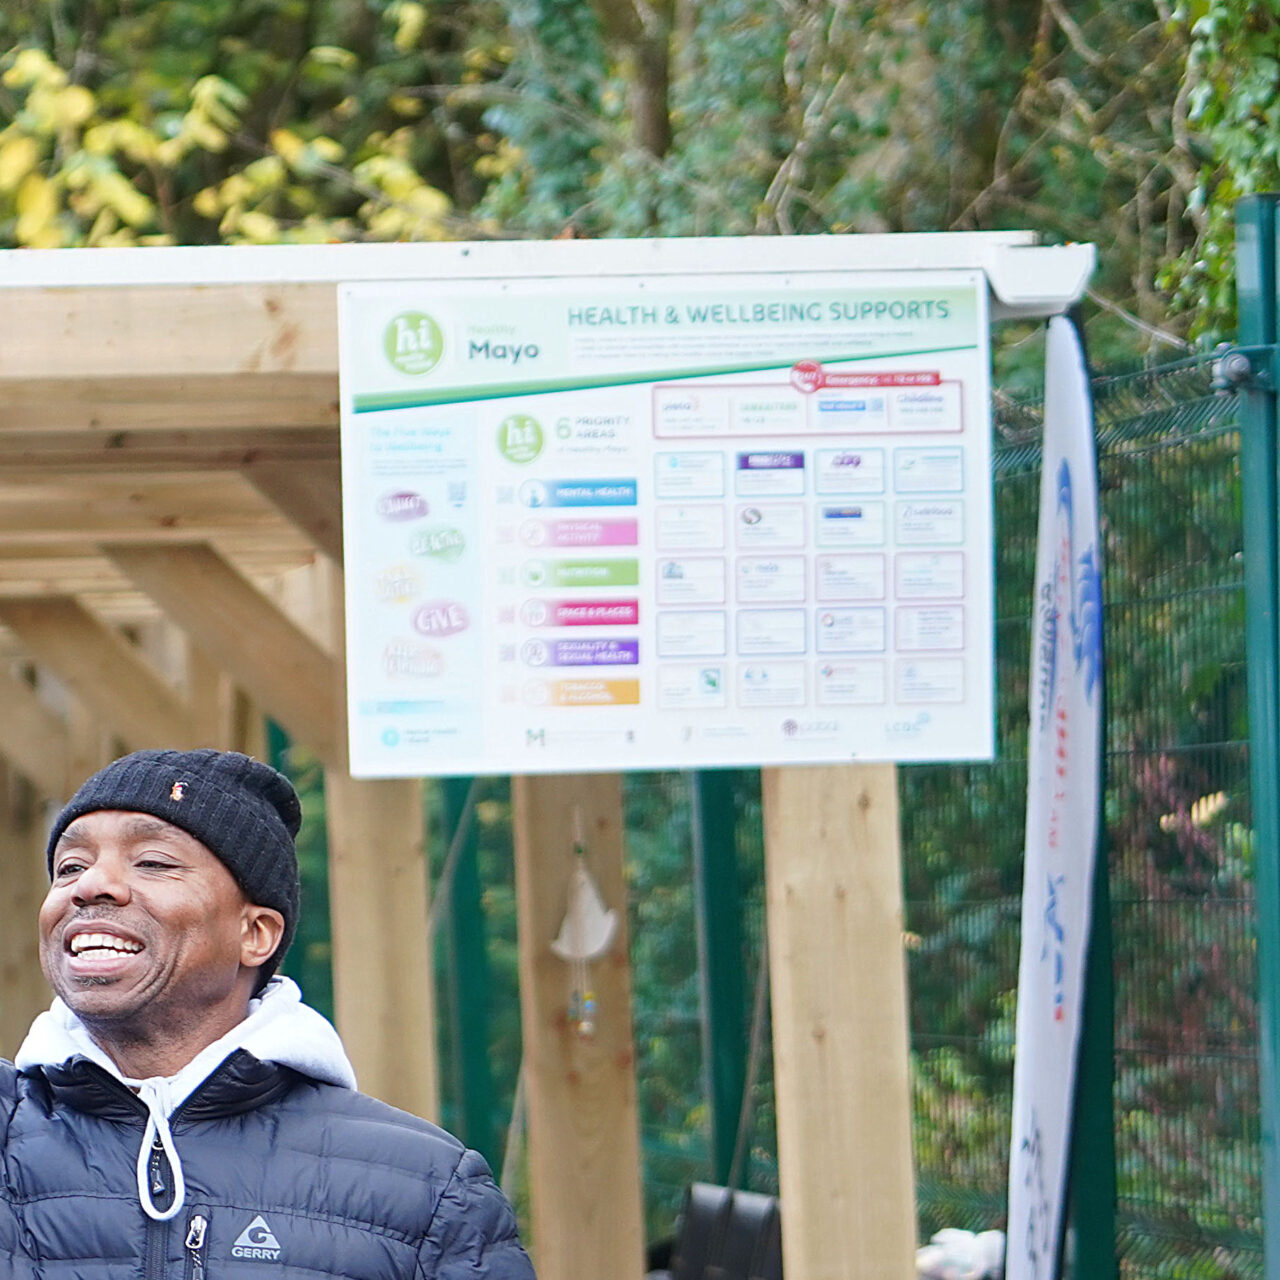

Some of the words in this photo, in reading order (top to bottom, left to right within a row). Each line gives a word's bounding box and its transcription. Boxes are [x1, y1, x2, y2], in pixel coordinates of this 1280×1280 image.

[569, 305, 657, 325] HEALTH
[664, 305, 680, 324] &
[686, 302, 821, 323] WELLBEING
[829, 301, 950, 321] SUPPORTS
[396, 318, 432, 353] hi
[469, 340, 540, 365] Mayo
[556, 417, 572, 439] 6
[231, 1246, 281, 1260] GERRY
